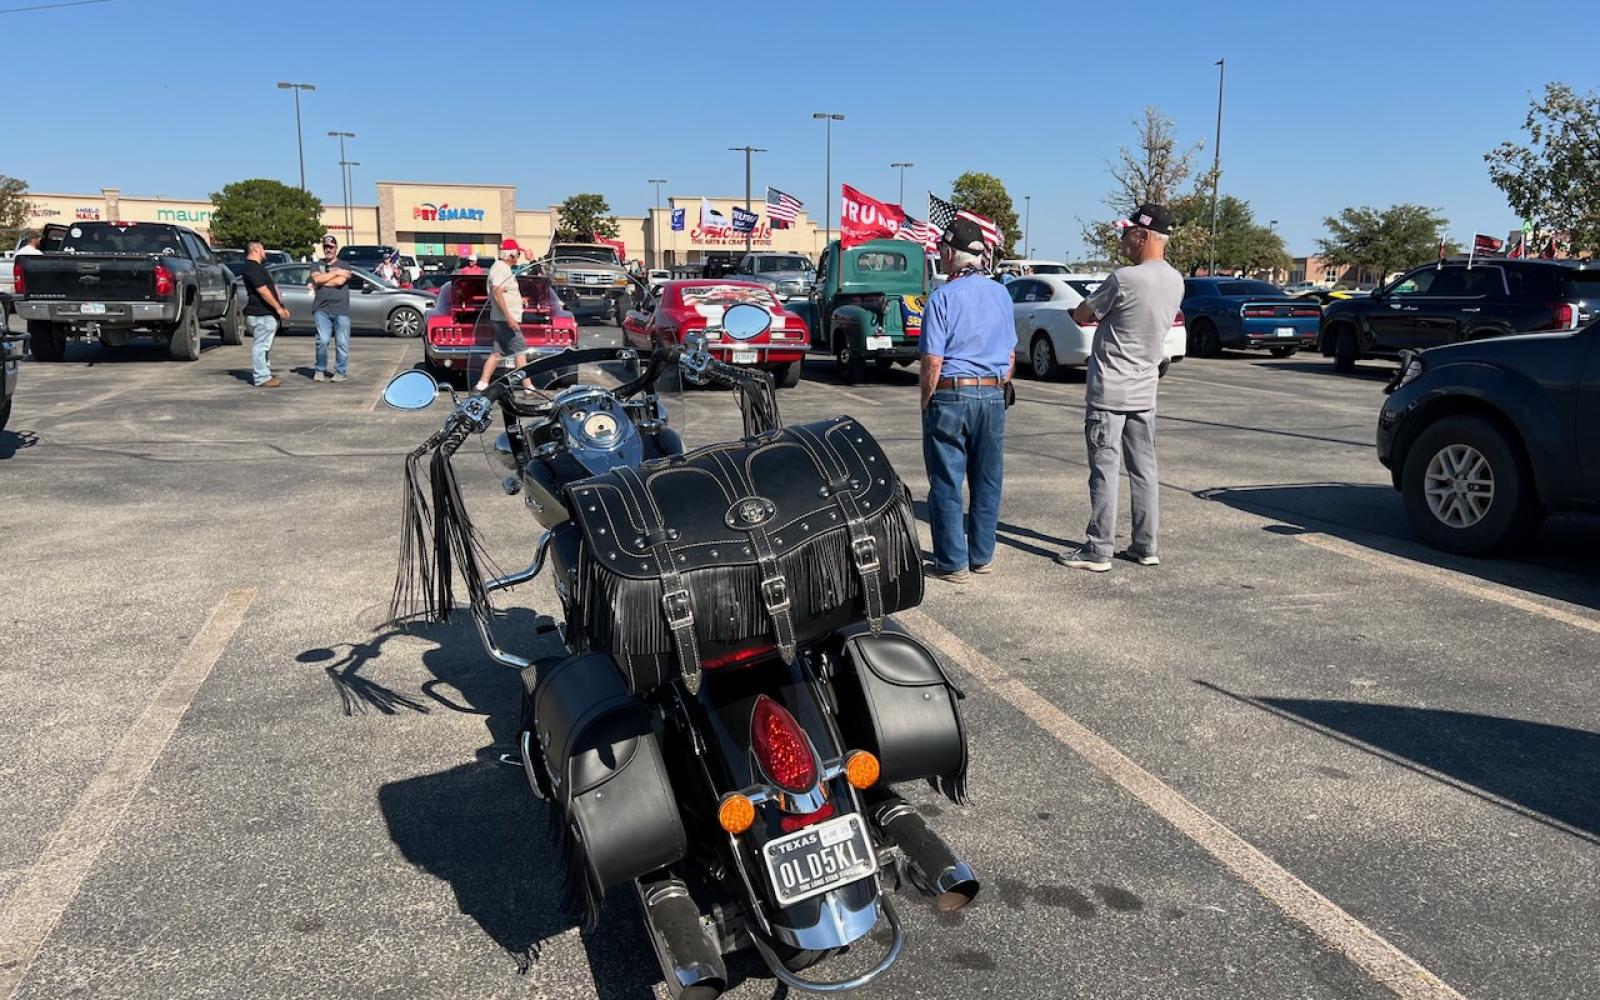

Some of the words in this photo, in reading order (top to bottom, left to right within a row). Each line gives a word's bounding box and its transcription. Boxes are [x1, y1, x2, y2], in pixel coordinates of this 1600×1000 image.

[157, 209, 211, 222] maur
[413, 207, 485, 221] PETSMART
[778, 834, 817, 854] TEXAS
